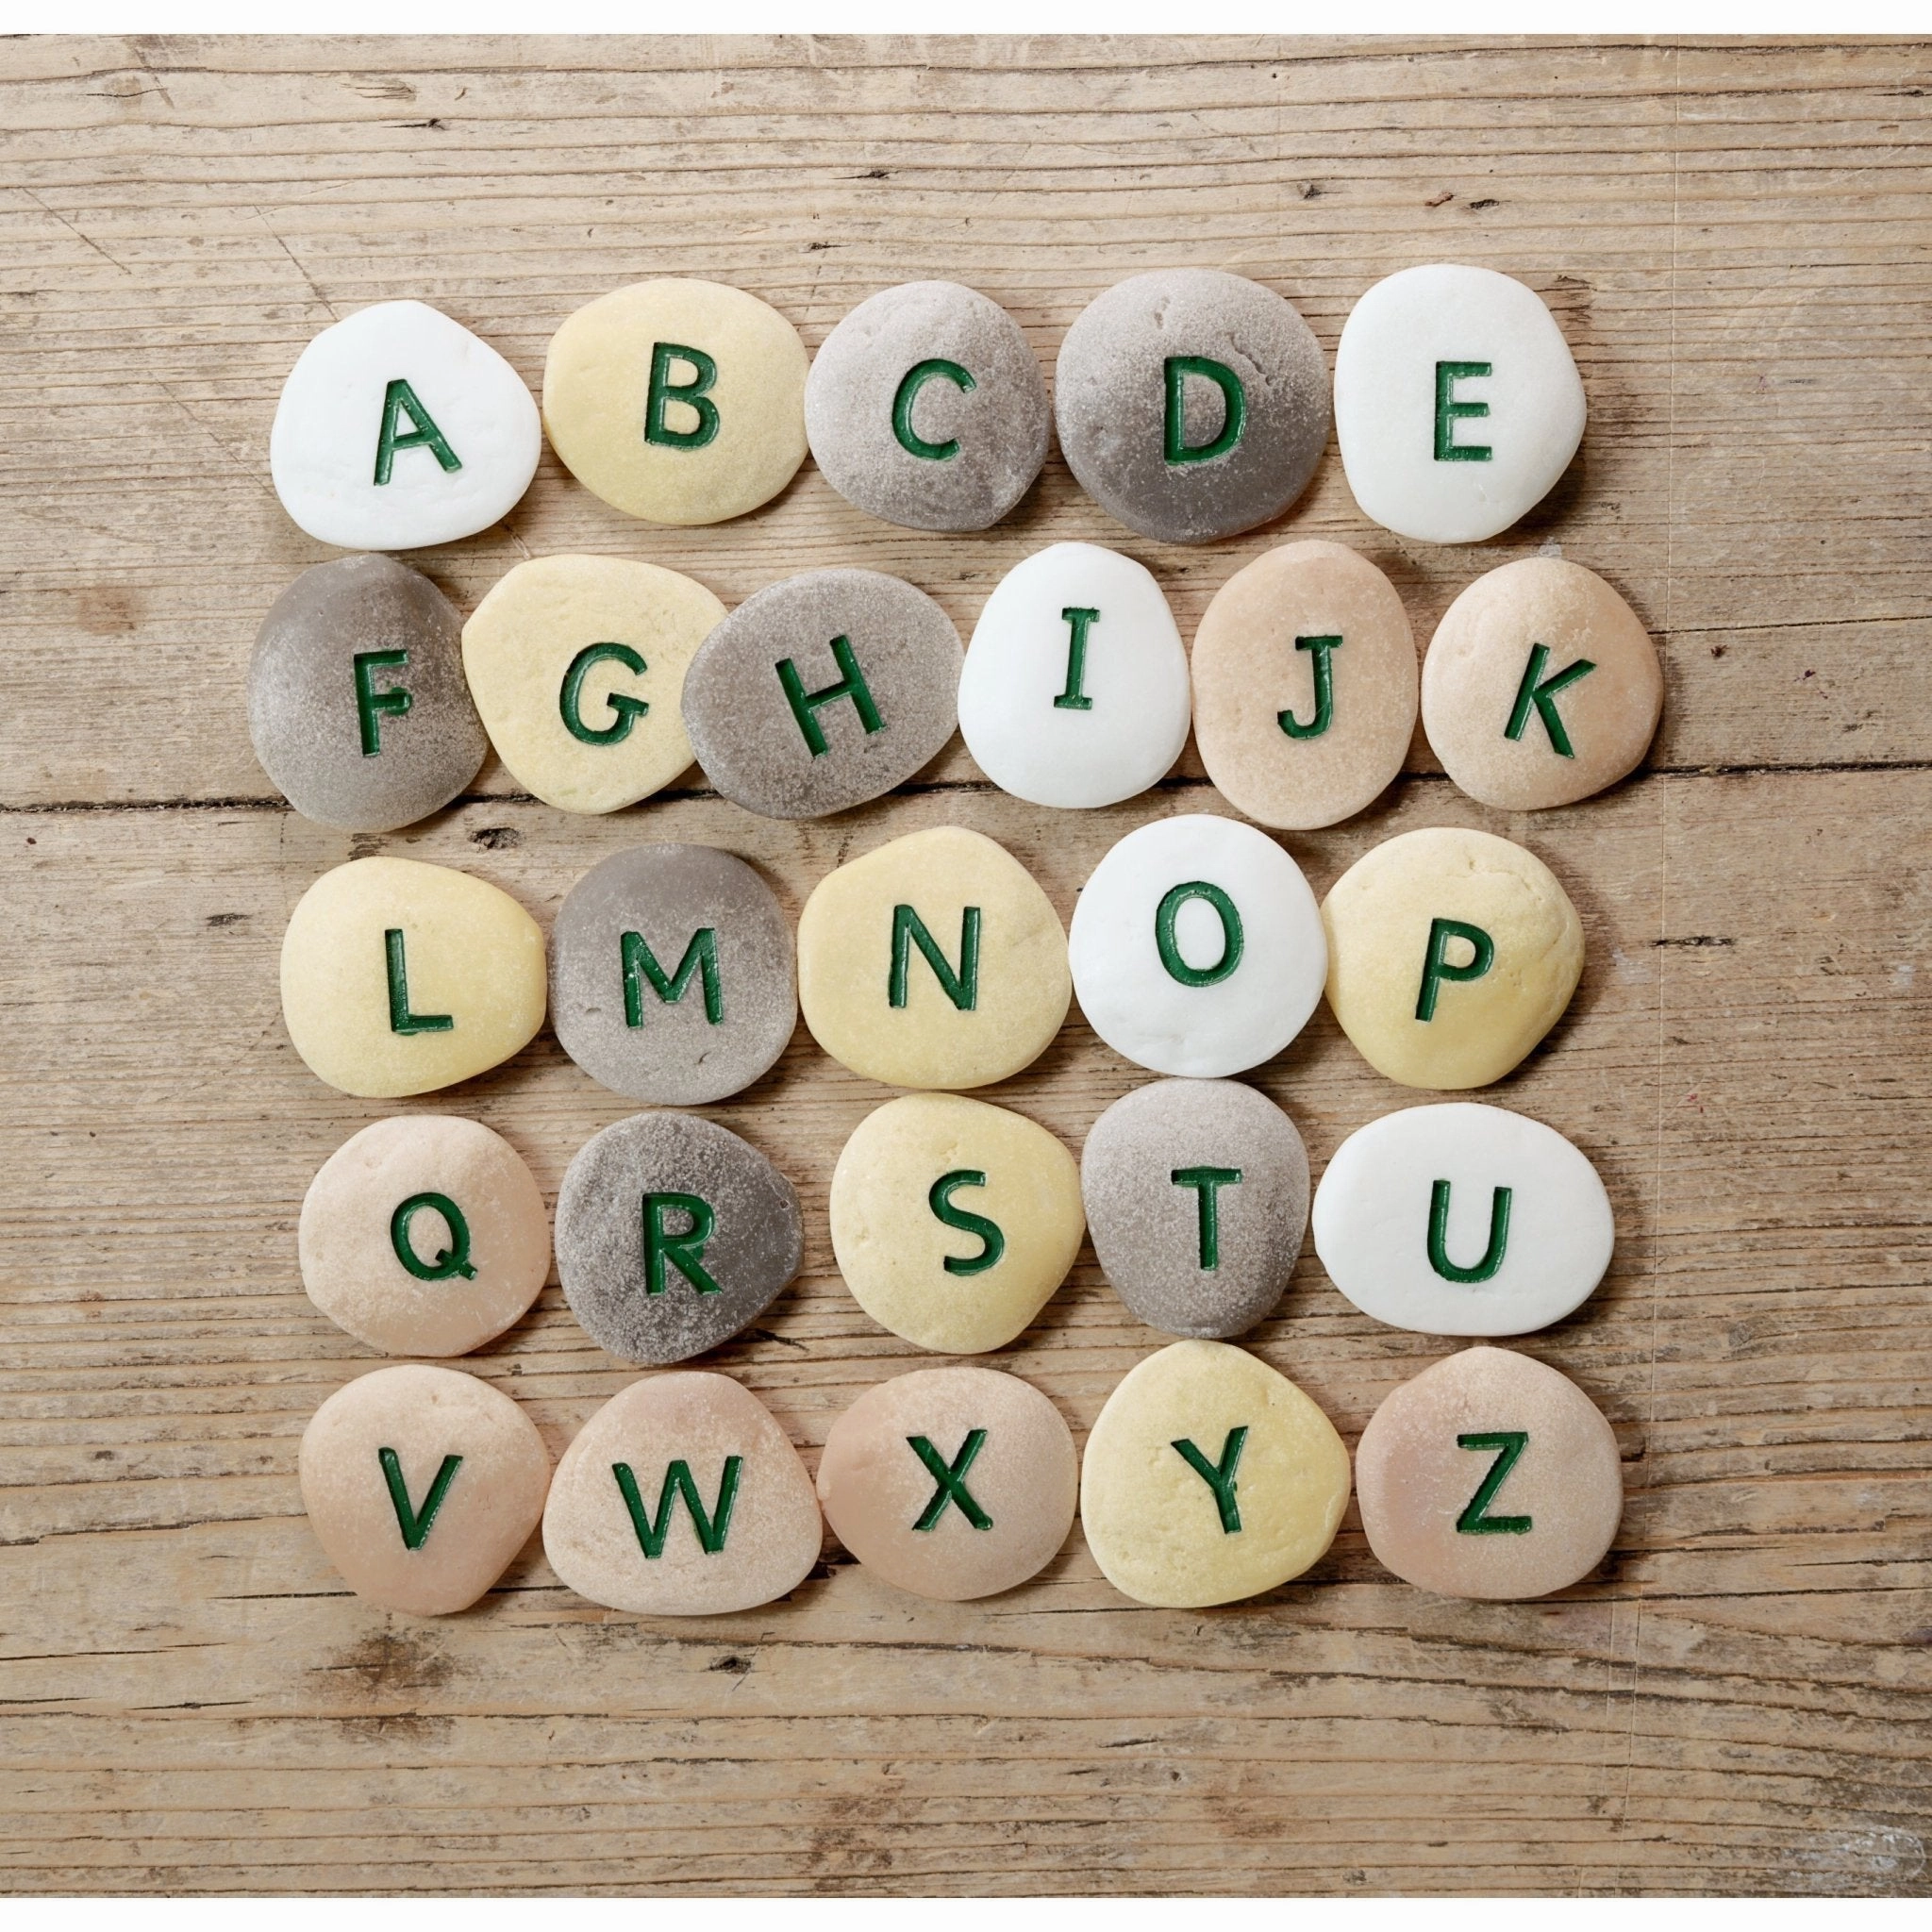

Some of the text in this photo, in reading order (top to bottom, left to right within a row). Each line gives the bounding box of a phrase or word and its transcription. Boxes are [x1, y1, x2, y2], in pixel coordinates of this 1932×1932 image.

[375, 379, 462, 485] A
[645, 342, 720, 450] B
[891, 358, 976, 461] C
[1163, 357, 1247, 466] D
[1434, 361, 1492, 461] E
[354, 649, 412, 757] F
[560, 643, 649, 745] G
[776, 635, 887, 758] H
[1054, 607, 1100, 710] I
[1279, 636, 1342, 740] J
[1505, 644, 1596, 757] K
[386, 929, 454, 1036] L
[621, 928, 724, 1028] M
[889, 905, 980, 1010] N
[1156, 881, 1244, 987] O
[1416, 919, 1494, 1022] P
[391, 1192, 477, 1281] Q
[641, 1191, 724, 1298] R
[929, 1170, 1005, 1276] S
[1171, 1166, 1242, 1272] T
[1427, 1179, 1512, 1283] U
[379, 1448, 462, 1550] V
[613, 1457, 742, 1558] W
[909, 1430, 992, 1531] X
[1174, 1426, 1248, 1533] Y
[1457, 1432, 1532, 1534] Z
